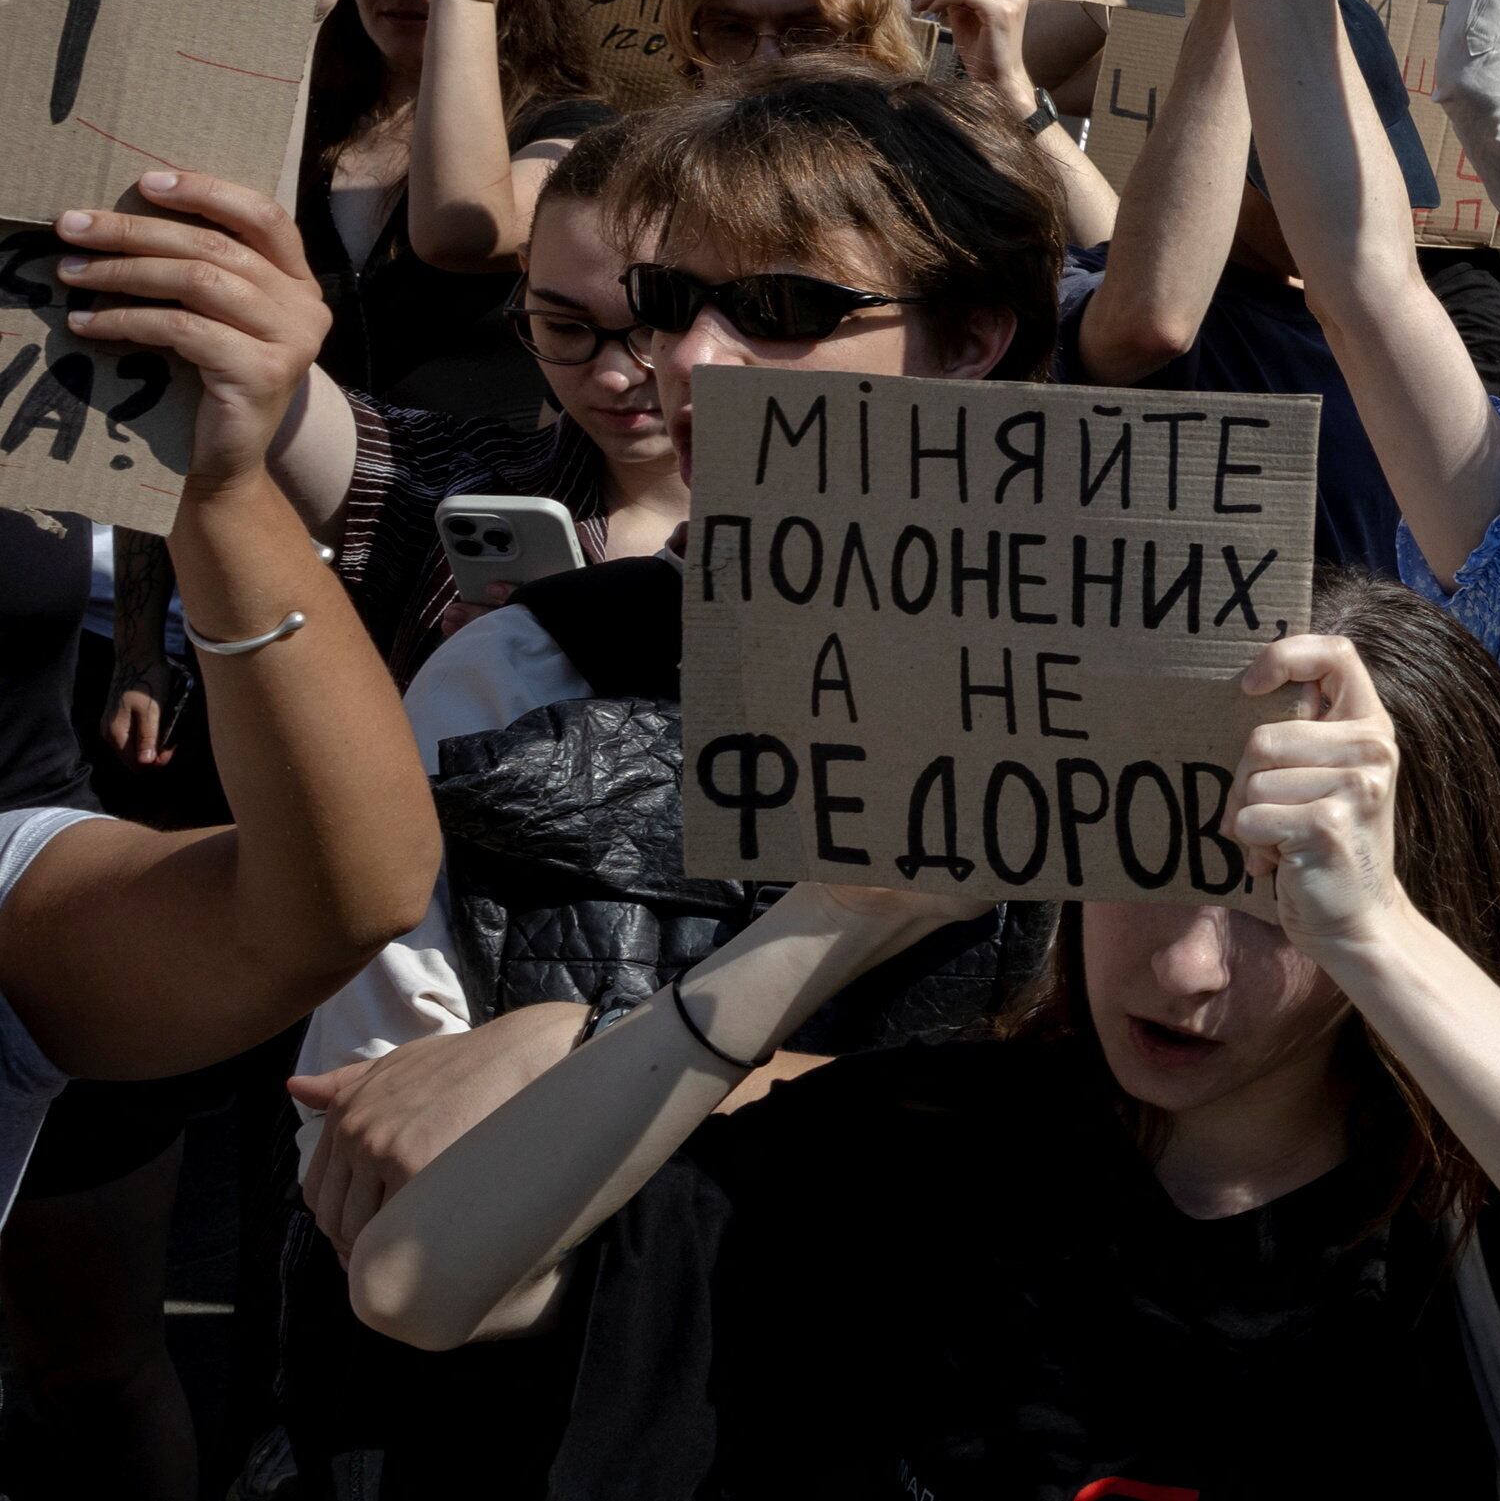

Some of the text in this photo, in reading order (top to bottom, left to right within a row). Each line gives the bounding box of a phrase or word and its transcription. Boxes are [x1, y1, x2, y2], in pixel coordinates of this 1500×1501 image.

[756, 380, 1271, 515] МІНЯЙТЕ
[702, 514, 1290, 641] ПОЛОНЕНИХ,
[811, 631, 1090, 741] А НЕ
[696, 731, 1257, 896] ФЕДОРОВ
